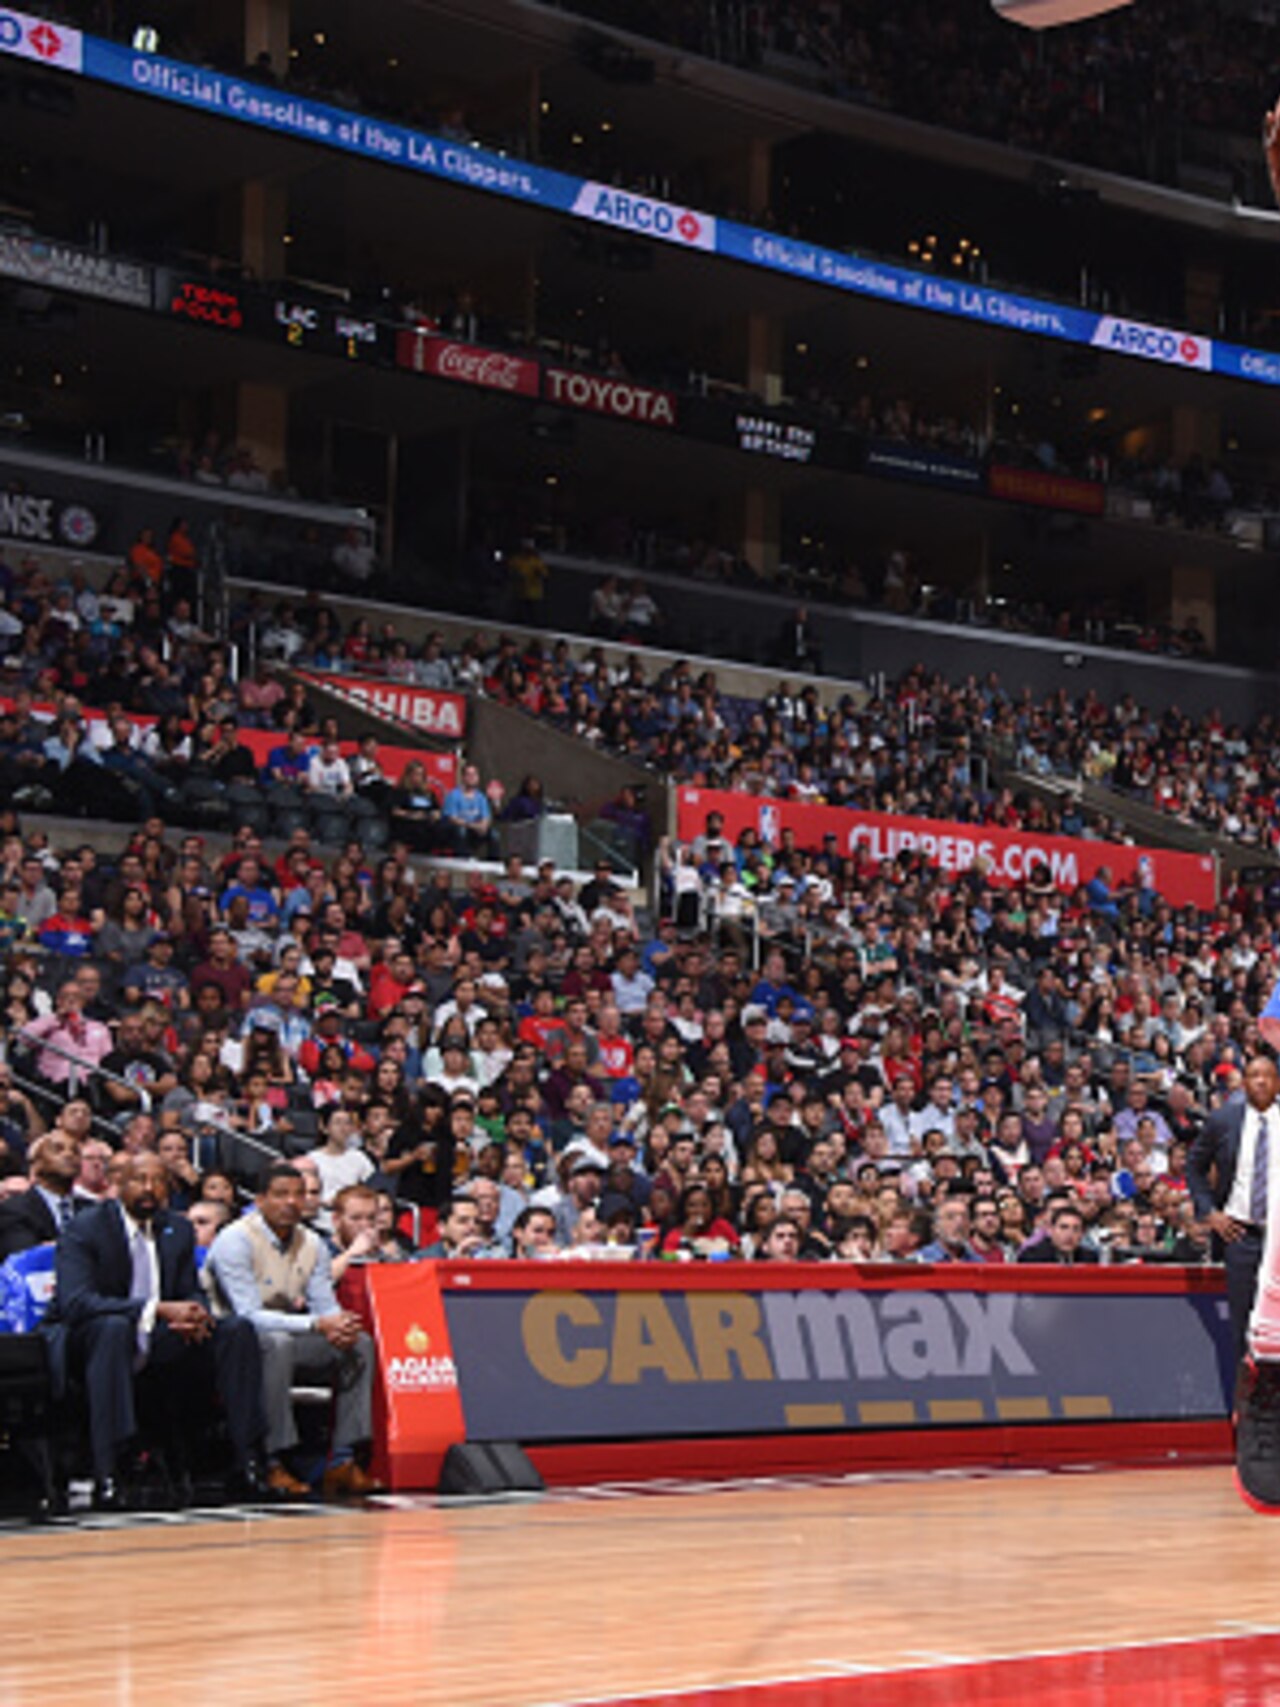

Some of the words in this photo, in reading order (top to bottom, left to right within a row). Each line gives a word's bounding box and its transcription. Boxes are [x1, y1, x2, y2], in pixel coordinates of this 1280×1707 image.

[132, 59, 222, 105] Official
[227, 85, 331, 136] Gasoline
[336, 120, 361, 144] of
[365, 125, 402, 156] the
[408, 136, 436, 166] LA
[443, 149, 541, 196] Clippers.
[594, 191, 674, 234] ARCO
[753, 235, 816, 273] Official
[820, 255, 898, 296] Gasoline
[903, 278, 923, 300] of
[925, 284, 955, 308] the
[960, 289, 983, 313] LA
[171, 297, 243, 328] FOULS
[180, 283, 238, 307] TEAM
[275, 302, 318, 330] LAC
[287, 323, 303, 346] 2
[347, 337, 358, 358] 1
[1110, 322, 1178, 359] ARCO
[547, 370, 674, 424] TOYOTA
[520, 1289, 1037, 1387] CARmax
